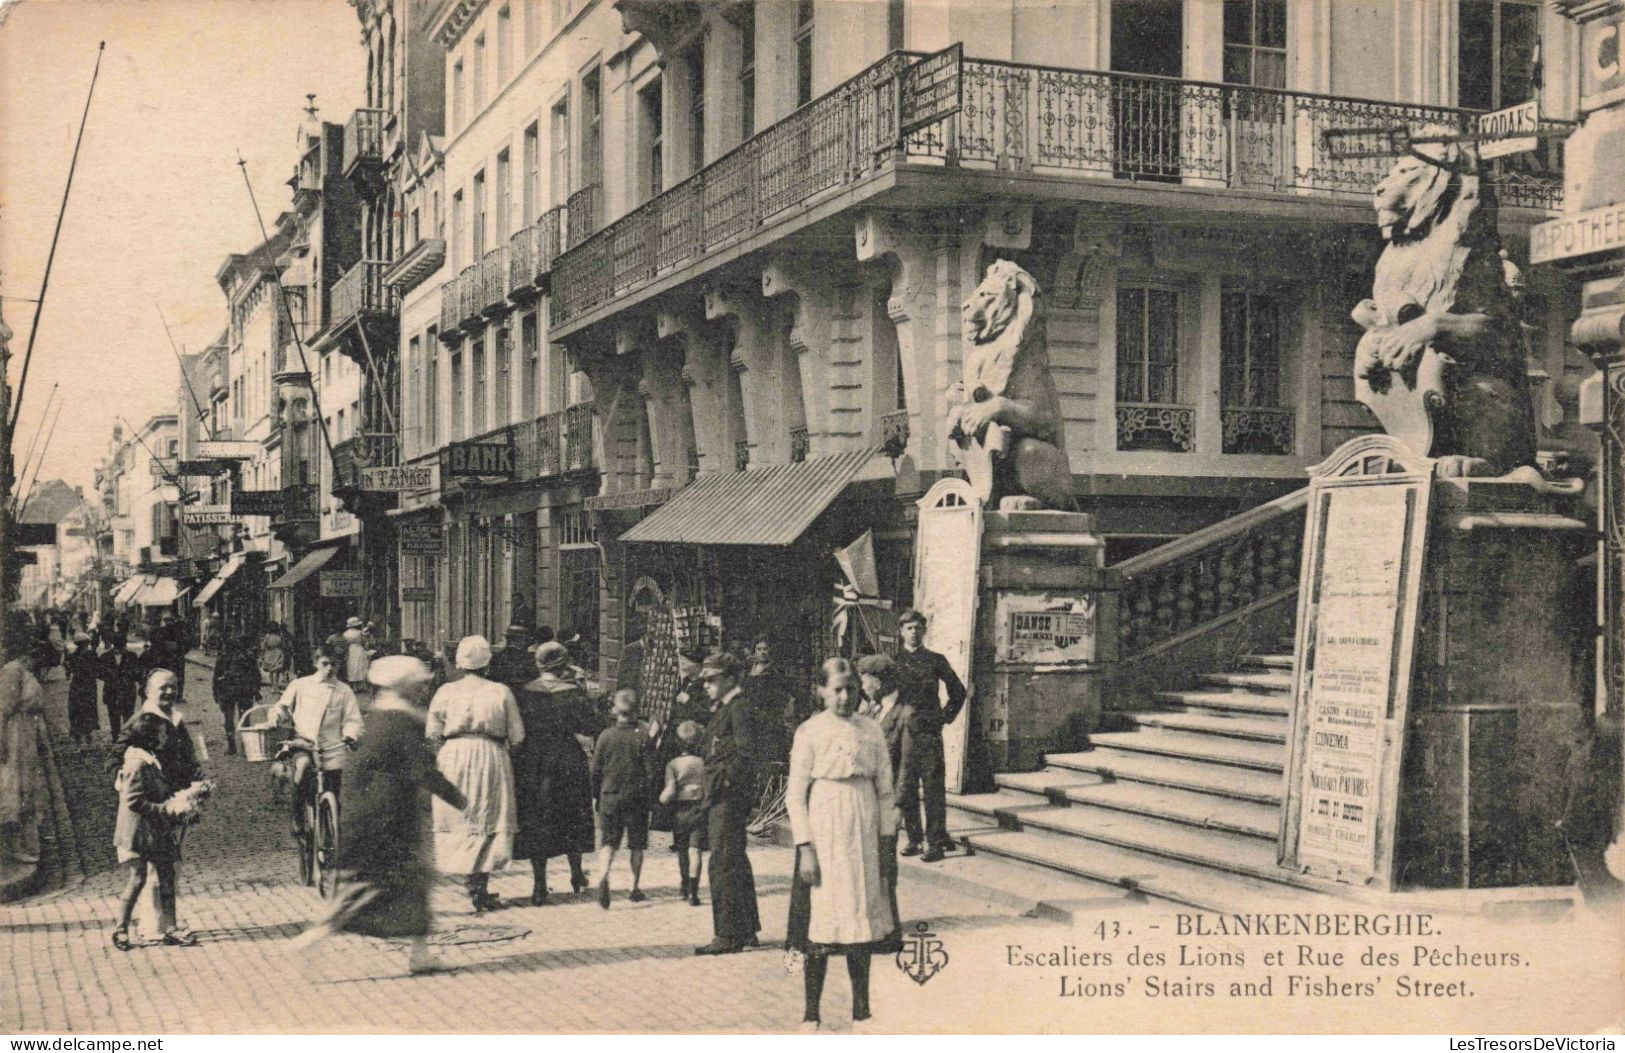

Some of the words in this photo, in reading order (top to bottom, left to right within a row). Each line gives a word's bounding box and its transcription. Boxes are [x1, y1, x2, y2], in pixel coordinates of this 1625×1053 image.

[1481, 105, 1536, 146] KODAKS
[452, 445, 513, 472] BANK
[1016, 615, 1051, 631] DANSE
[1315, 731, 1349, 749] CINEMA
